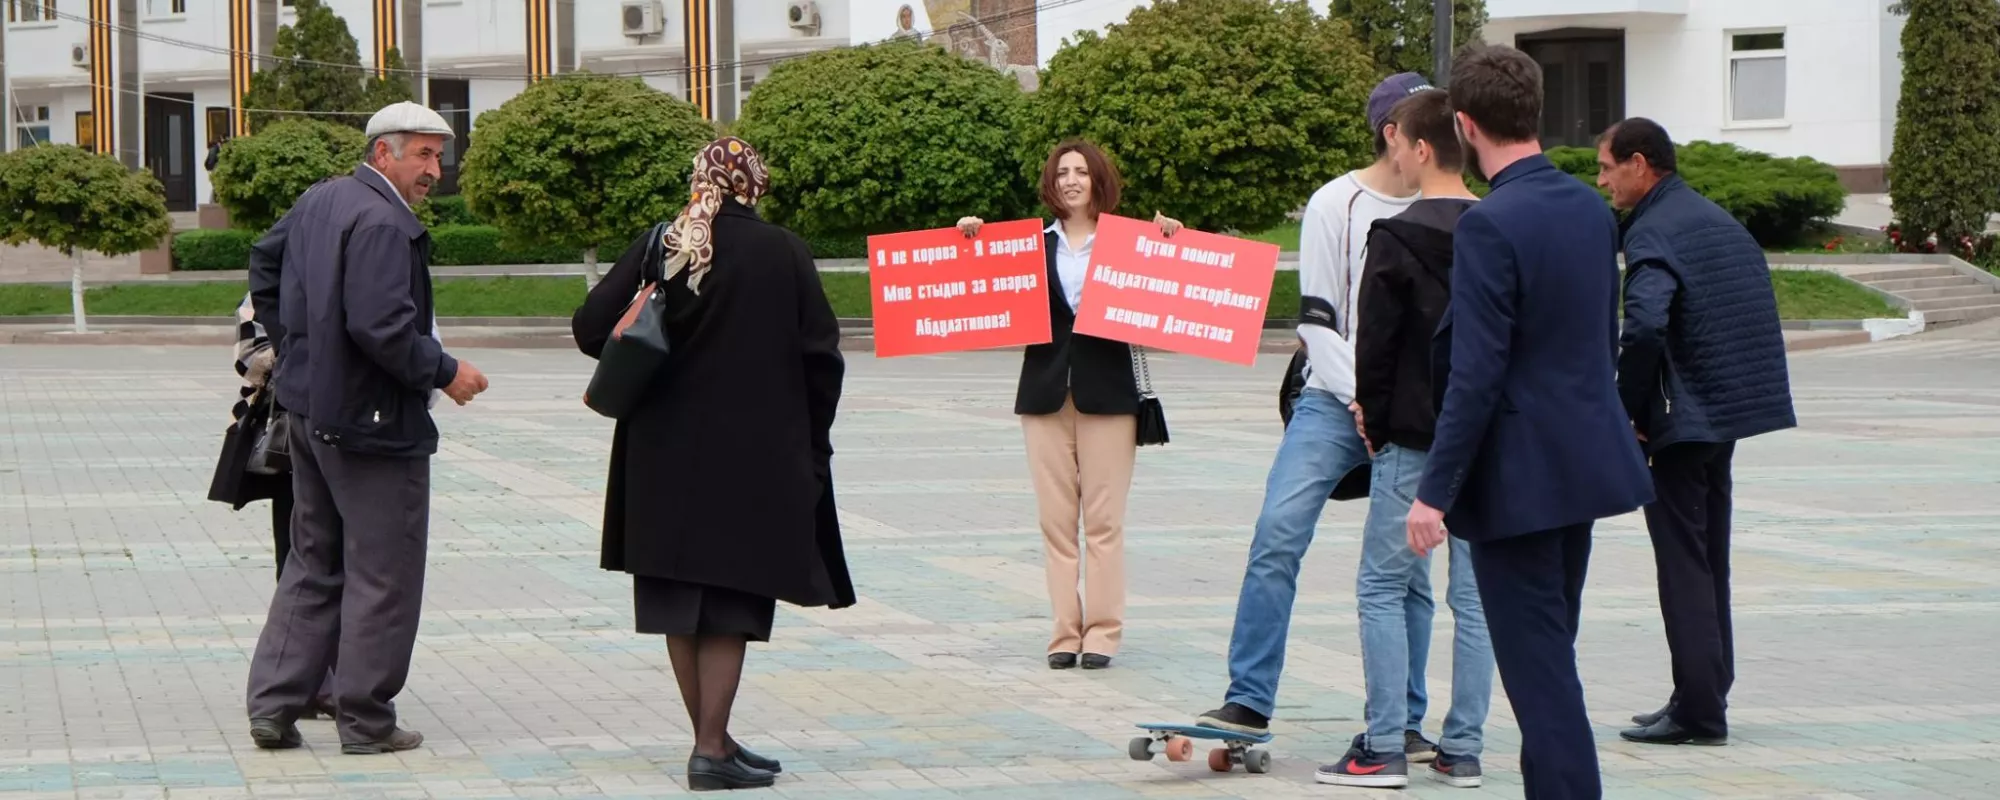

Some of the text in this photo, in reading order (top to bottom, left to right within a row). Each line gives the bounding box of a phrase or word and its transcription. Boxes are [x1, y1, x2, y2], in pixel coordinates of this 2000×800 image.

[877, 250, 885, 266] Я
[892, 251, 907, 264] не
[913, 246, 957, 264] корова
[975, 240, 983, 256] Я
[989, 234, 1038, 256] аварка!
[1136, 236, 1235, 268] Путин помоги!
[884, 274, 1037, 302] Мне стыдно за аварца
[1093, 265, 1261, 310] Абдулатипов оскорбляет
[916, 311, 1010, 337] Абдулатипова!
[1105, 307, 1234, 342] женщин Дагестана
